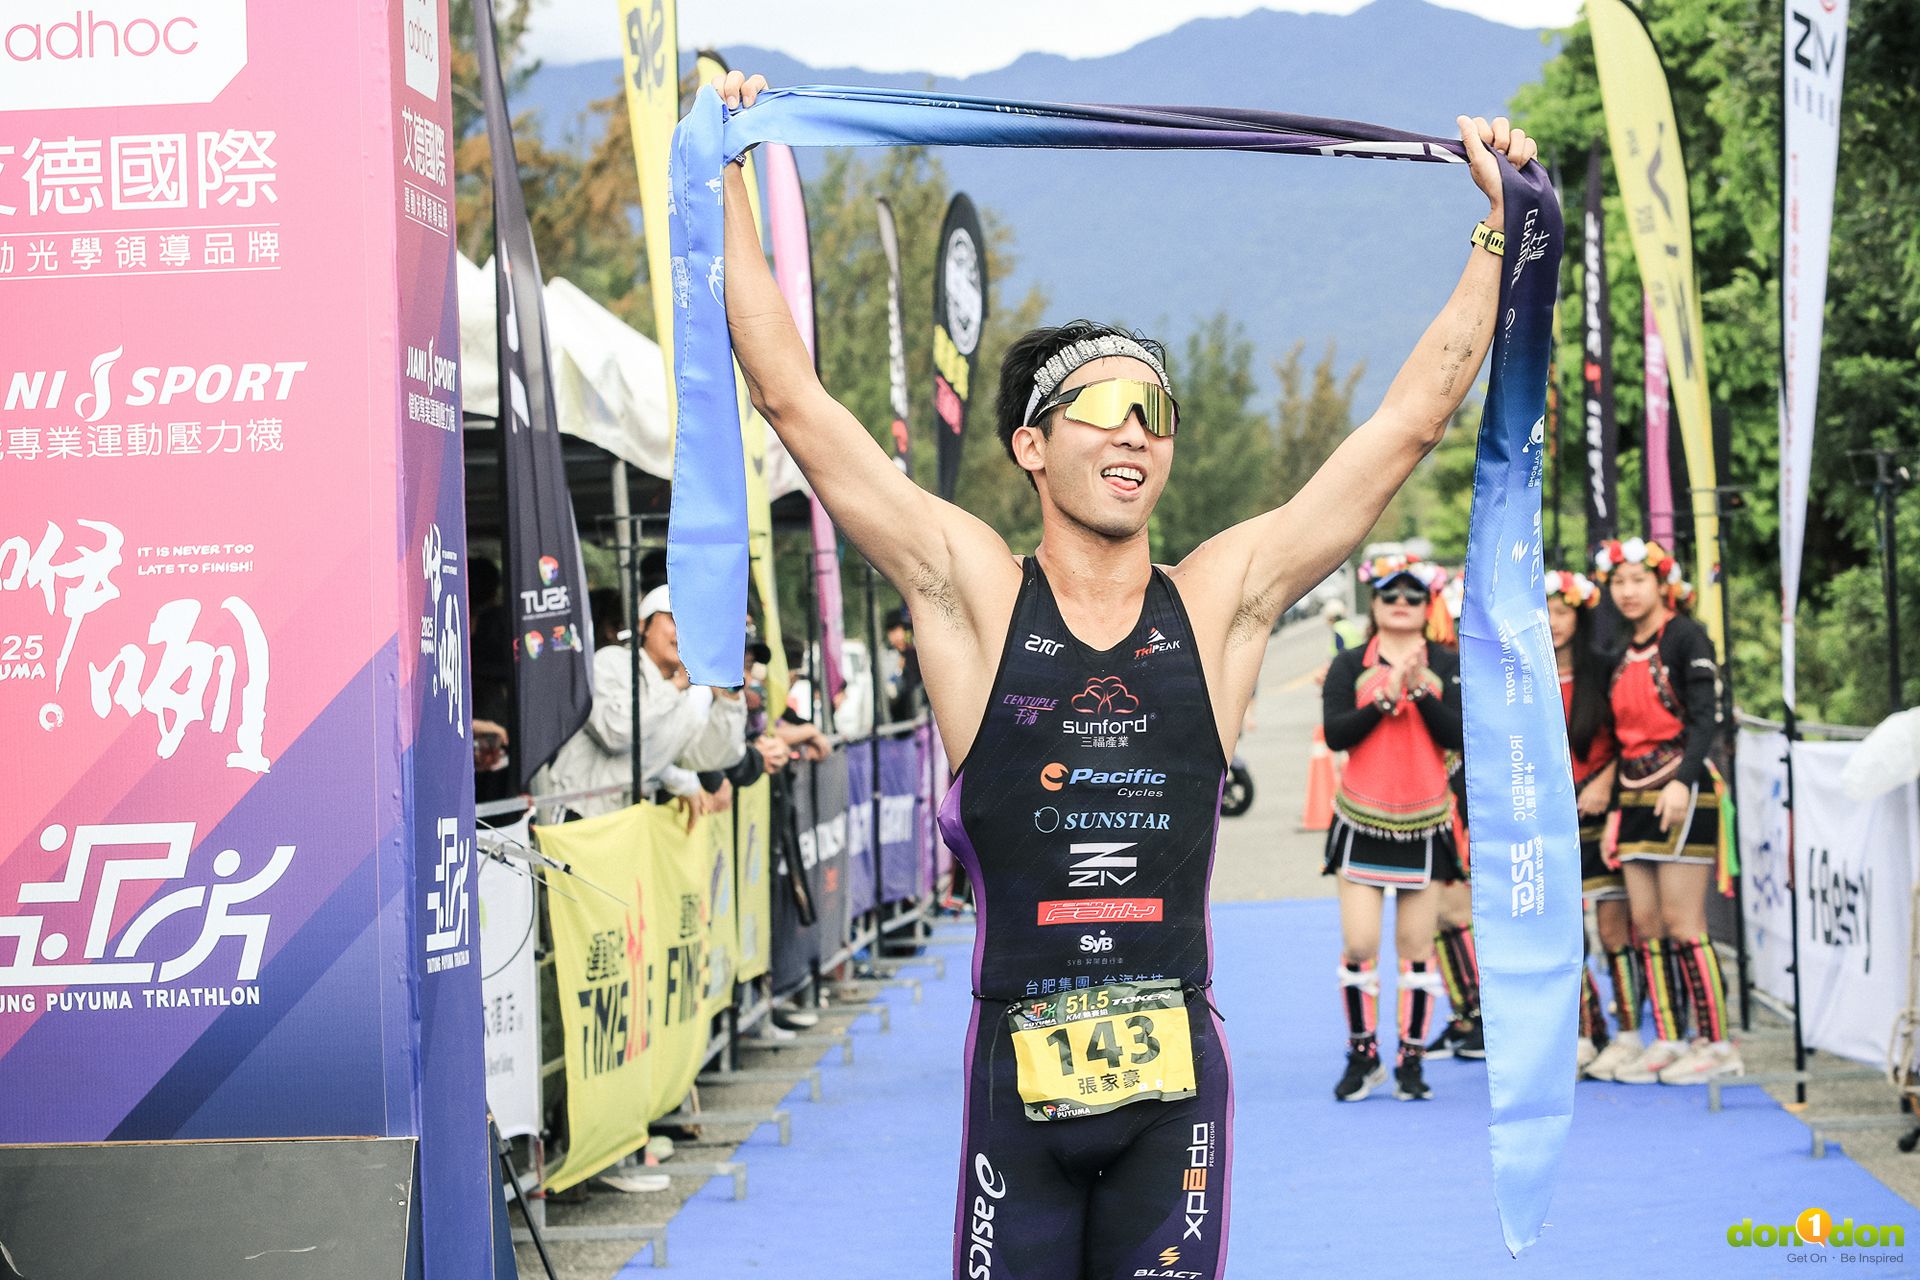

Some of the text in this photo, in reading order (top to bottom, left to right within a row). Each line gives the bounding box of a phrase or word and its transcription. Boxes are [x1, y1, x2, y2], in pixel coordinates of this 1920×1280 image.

[4, 9, 199, 62] adhoc
[402, 105, 446, 187] 艾德國際
[0, 128, 279, 216] 德國際
[406, 346, 456, 392] JIANI SPORT
[125, 361, 308, 406] SPORT
[0, 418, 285, 461] 專業運動壓力襪
[138, 544, 254, 557] IT IS NEVER TOO
[138, 561, 254, 576] LATE TO FINISH!
[1003, 694, 1060, 709] CENTUPLE
[1063, 715, 1147, 735] sunford
[1081, 736, 1129, 748] 三福產業
[1069, 767, 1167, 786] Pacific
[1117, 787, 1164, 798] Cycles
[1064, 812, 1171, 831] SUNSTAR
[1068, 870, 1137, 887] ZIV
[46, 990, 133, 1012] PUYUMA
[143, 986, 260, 1008] TRIATHLON
[1066, 990, 1109, 1014] 51.5
[1065, 1013, 1081, 1022] KM
[1046, 1016, 1161, 1077] 143
[1077, 1068, 1141, 1096] 張家豪
[1057, 1107, 1091, 1119] PUYUMA
[1134, 1268, 1202, 1280] BLACT
